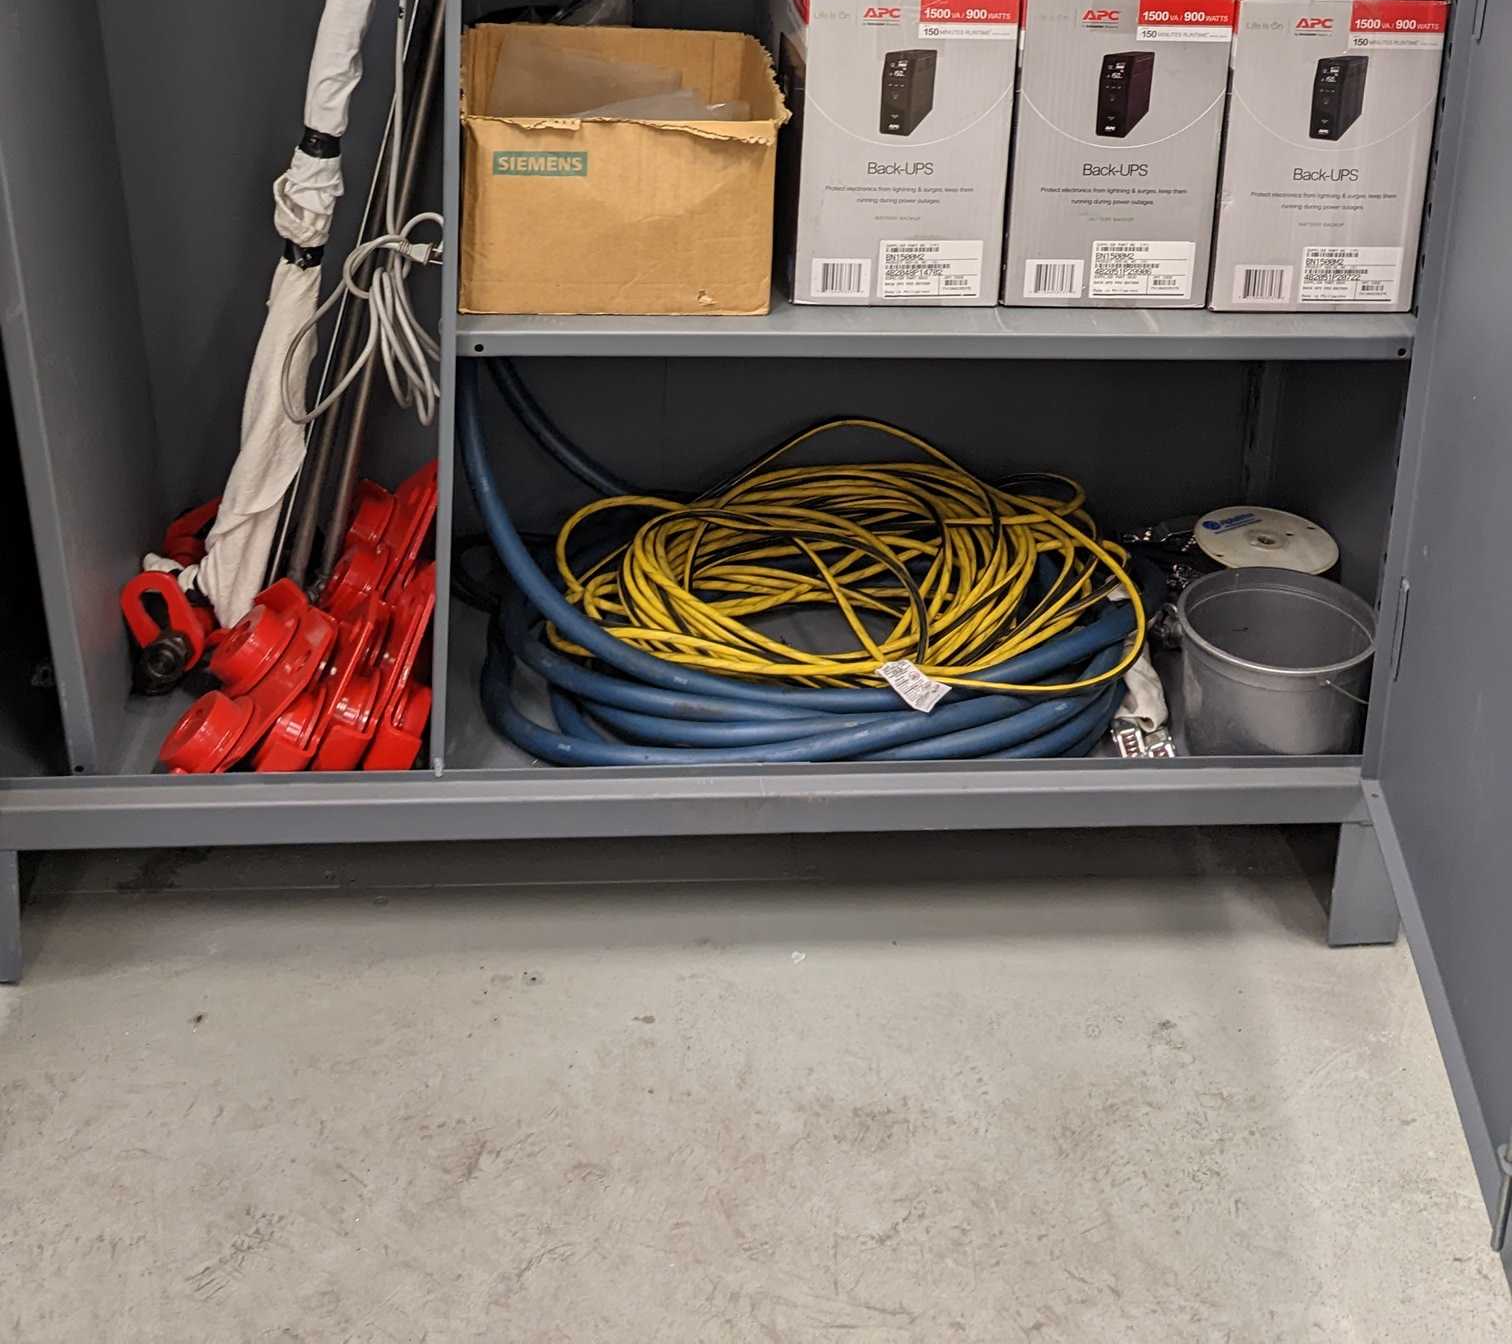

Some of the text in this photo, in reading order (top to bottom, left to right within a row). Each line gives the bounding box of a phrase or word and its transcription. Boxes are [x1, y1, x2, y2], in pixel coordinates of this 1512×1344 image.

[863, 8, 901, 19] APC
[923, 9, 951, 20] 1500
[966, 10, 987, 20] 900
[1083, 9, 1120, 21] APC
[1142, 11, 1169, 21] 1500
[1184, 11, 1205, 22] 900
[1296, 18, 1334, 29] APC
[1354, 19, 1381, 29] 1500
[1395, 20, 1416, 30] 900
[924, 28, 939, 36] 150
[1142, 30, 1157, 38] 150
[1353, 38, 1368, 46] 150
[498, 156, 583, 171] SIEMENS
[867, 161, 934, 176] Back-UPS
[1083, 163, 1149, 176] Back-UPS
[1293, 167, 1359, 182] Back-UPS
